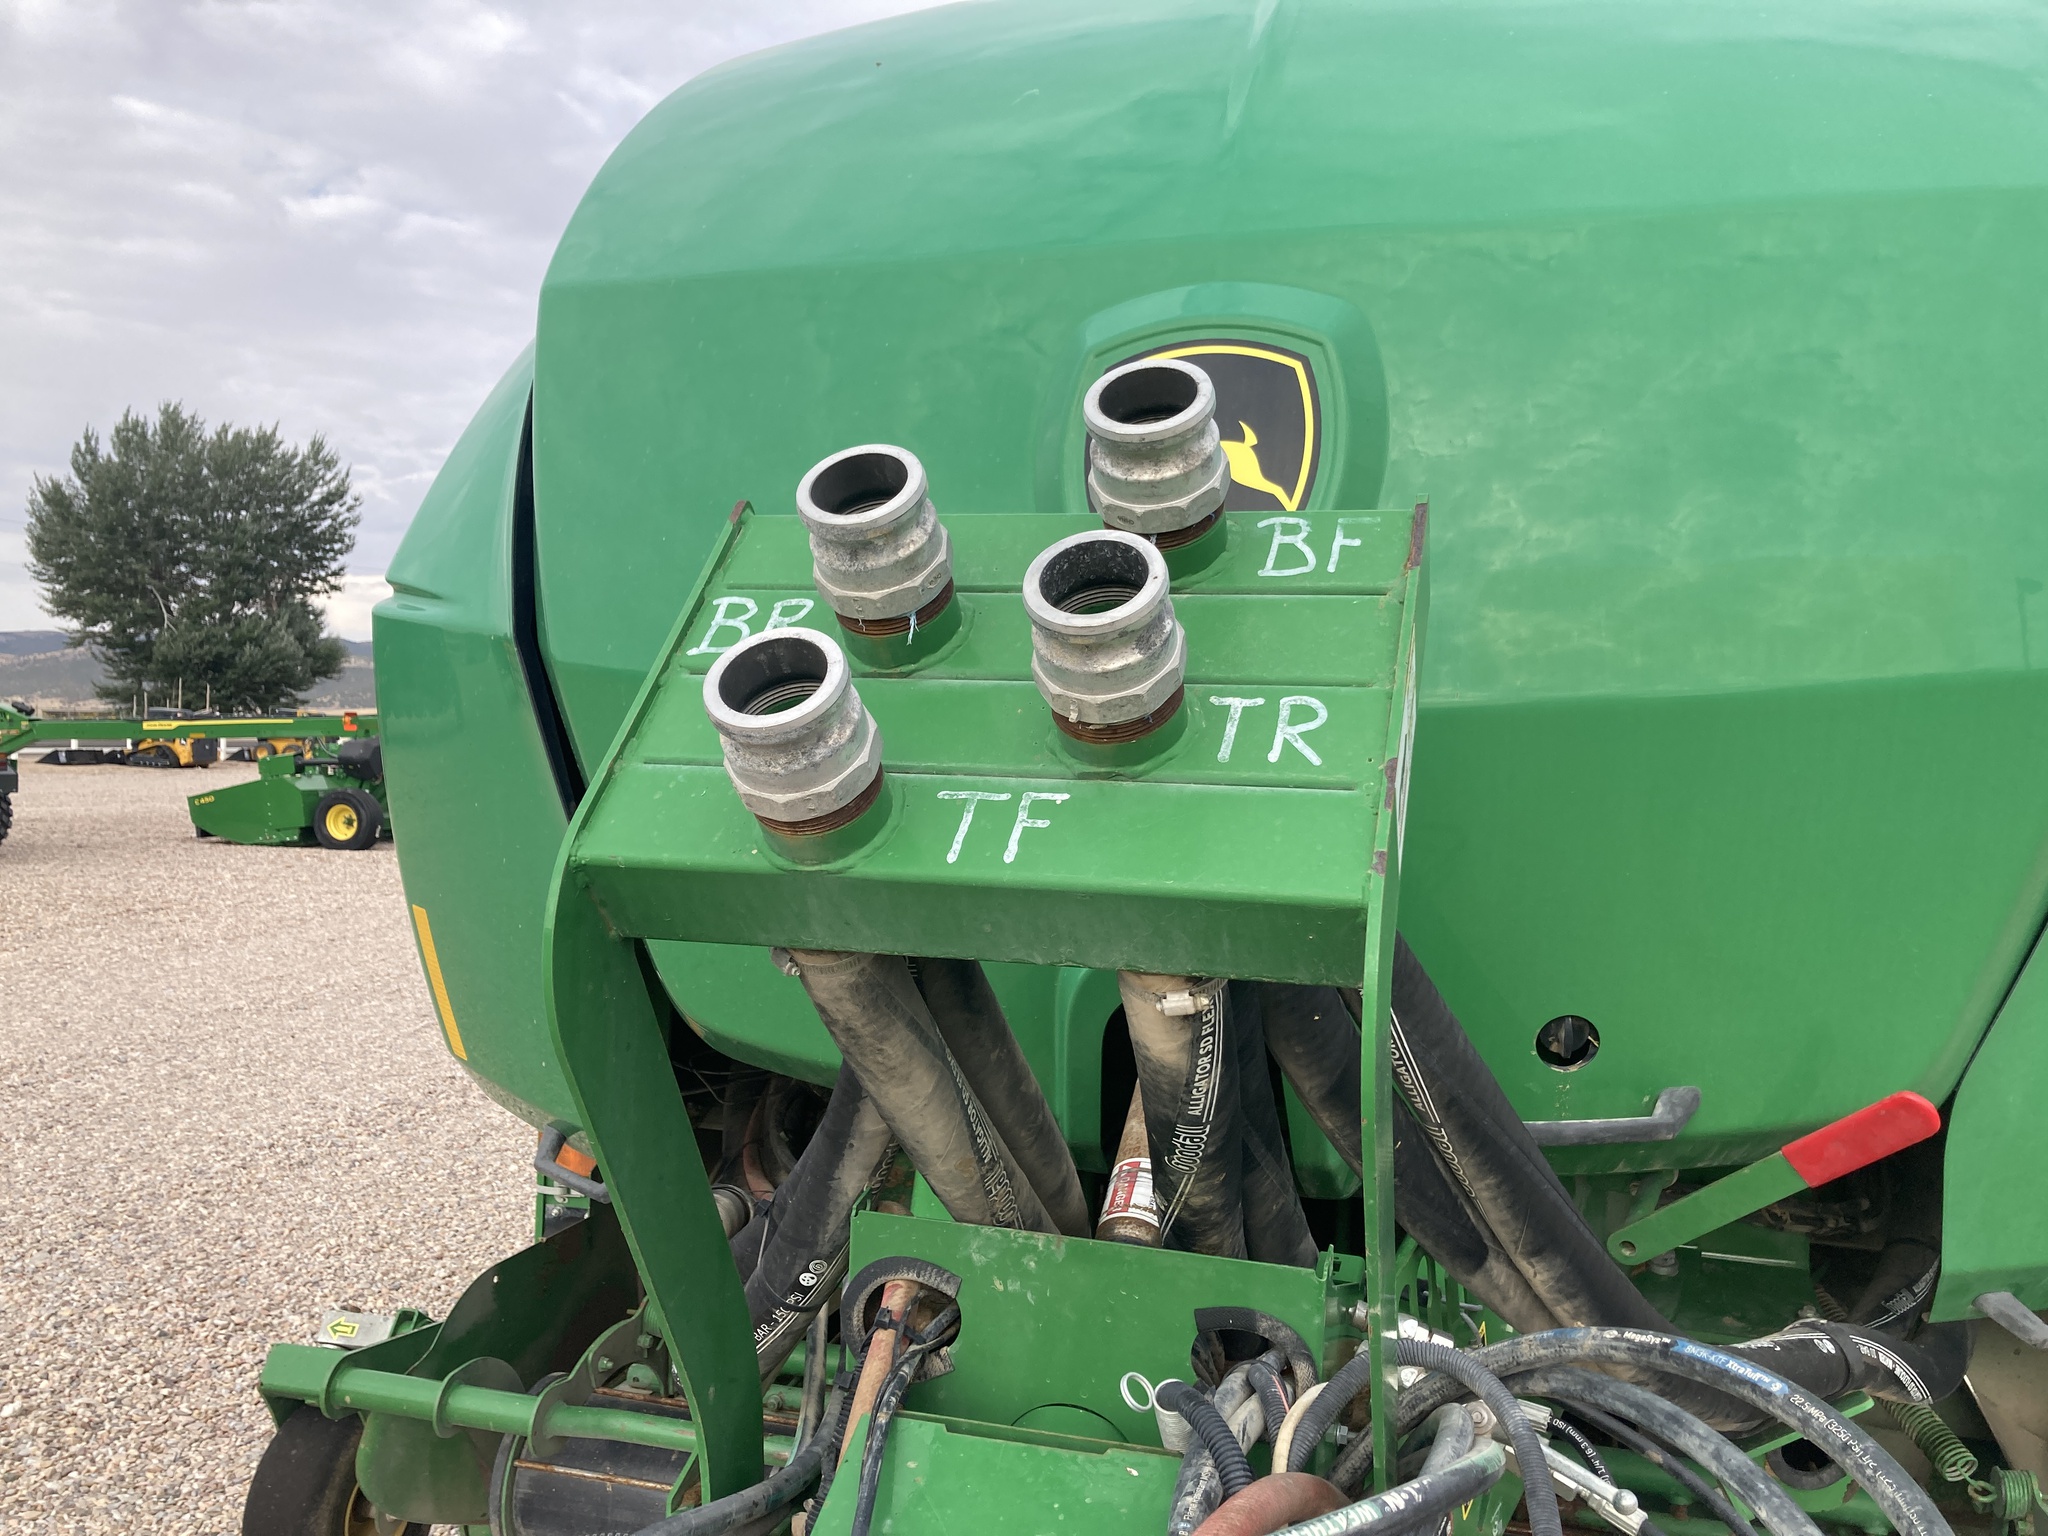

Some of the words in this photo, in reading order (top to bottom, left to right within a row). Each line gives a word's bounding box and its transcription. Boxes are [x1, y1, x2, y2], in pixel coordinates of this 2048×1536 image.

[1256, 515, 1381, 578] BF
[1209, 695, 1329, 767] TR
[937, 790, 1071, 864] TF
[1199, 1036, 1214, 1054] SD
[1188, 1055, 1211, 1115] ALLIGATOR
[752, 1323, 772, 1341] BAR
[786, 1291, 804, 1304] PSI
[1552, 1418, 1566, 1428] ISO
[1565, 1425, 1583, 1442] mm)
[1789, 1394, 1809, 1411] 22.5
[1808, 1406, 1826, 1423] MPa
